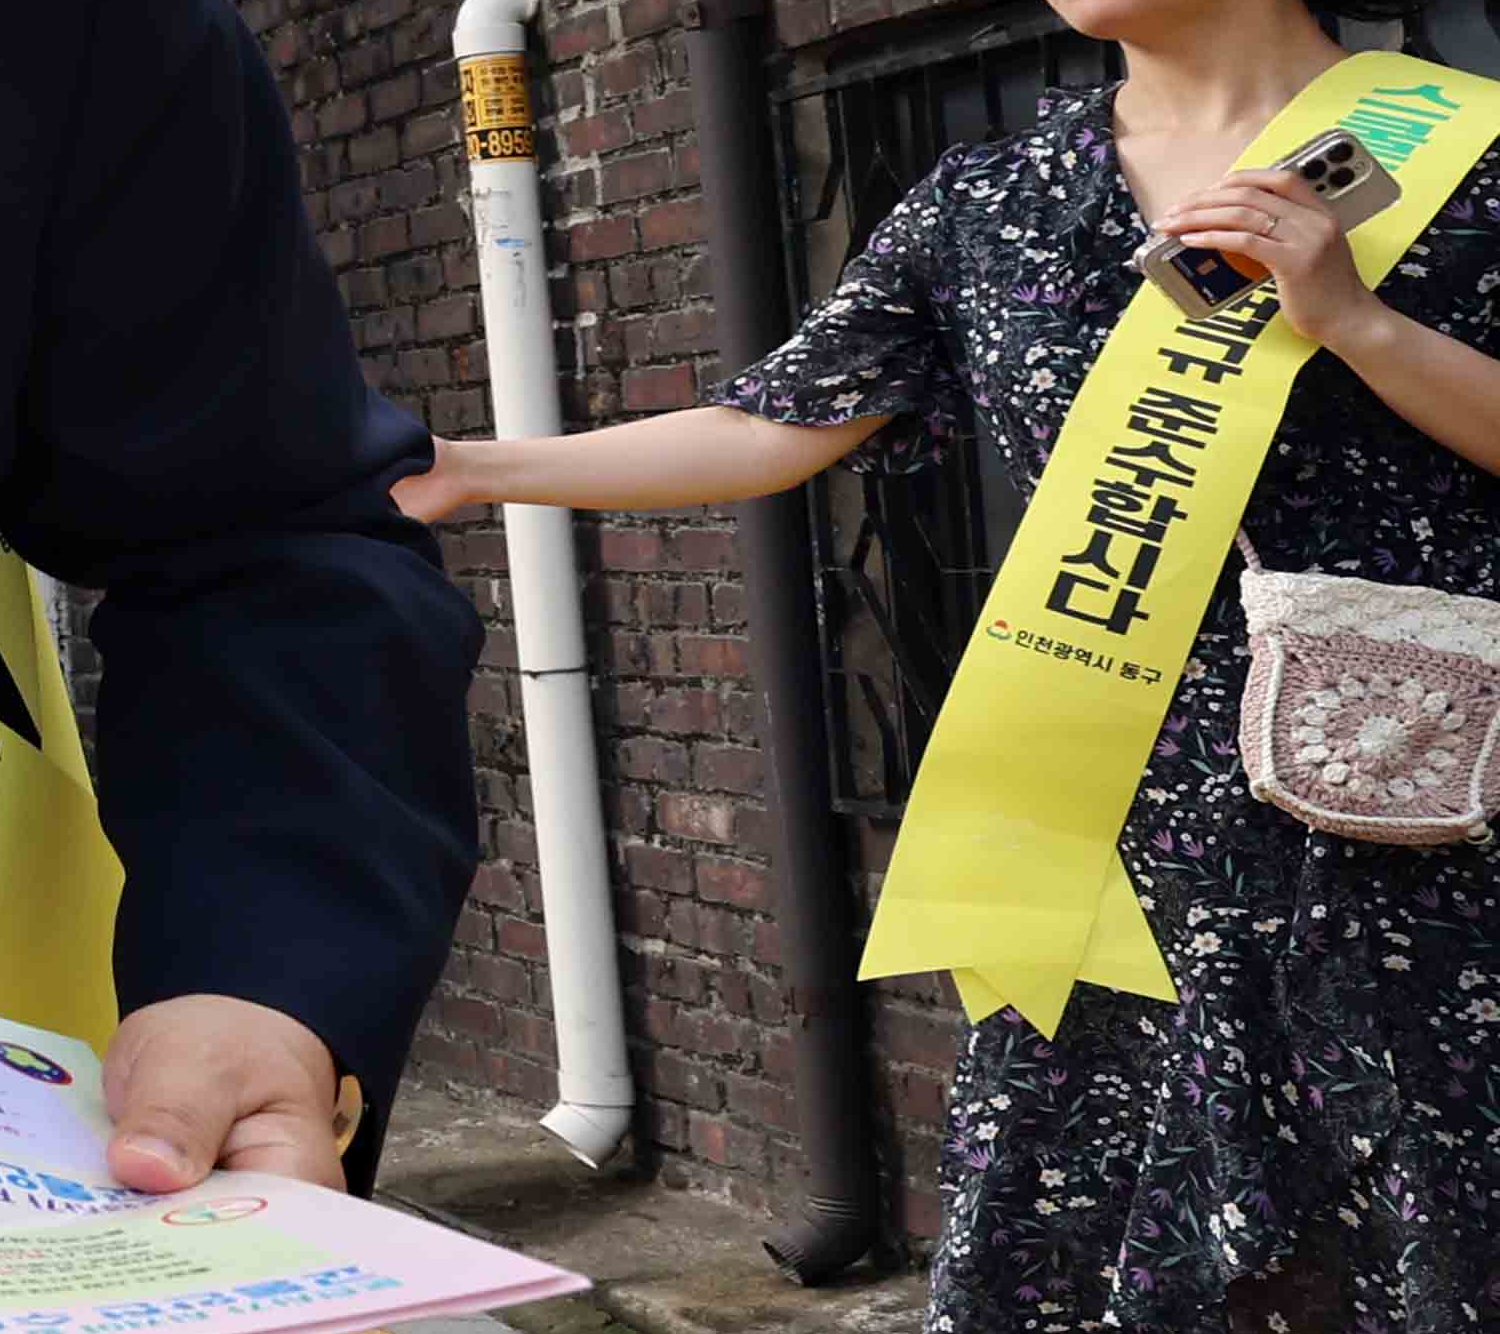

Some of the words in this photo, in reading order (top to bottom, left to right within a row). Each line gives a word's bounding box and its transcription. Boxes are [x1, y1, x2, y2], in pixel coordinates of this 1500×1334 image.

[1338, 84, 1461, 171] 스쿨
[1045, 385, 1221, 635] 준수합시다
[1014, 627, 1112, 673] 인천광역시
[1118, 657, 1164, 685] 동구
